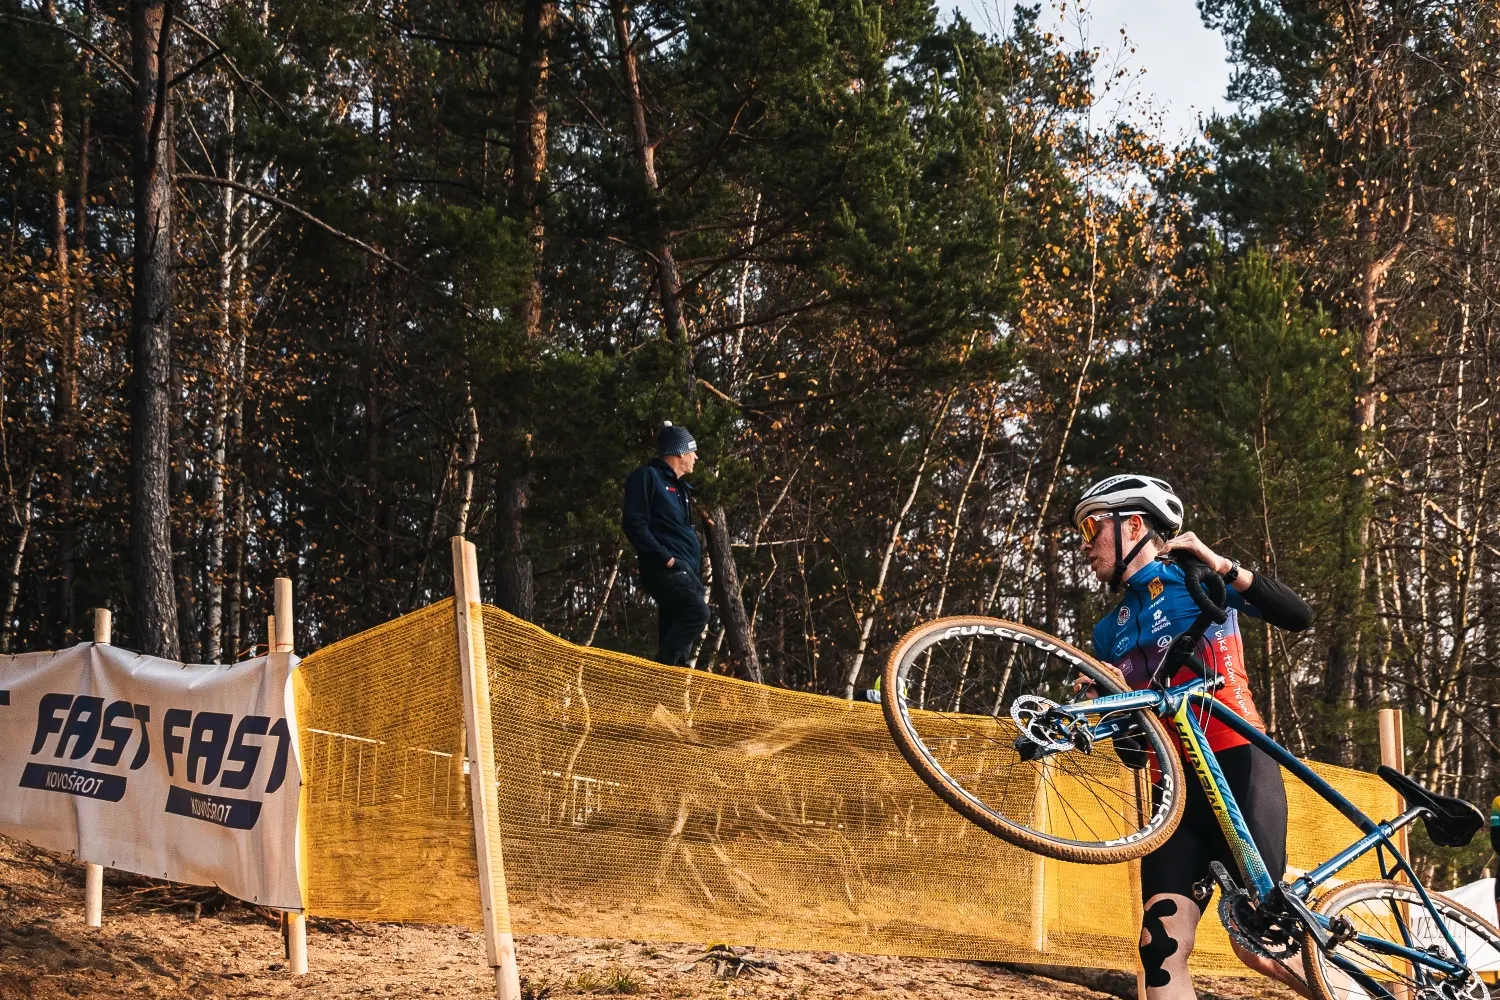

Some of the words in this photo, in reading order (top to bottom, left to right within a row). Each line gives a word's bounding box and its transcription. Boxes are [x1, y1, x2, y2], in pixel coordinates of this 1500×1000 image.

[944, 625, 1084, 666] FULCRUM
[1214, 629, 1228, 652] bike
[1223, 654, 1236, 684] team
[1093, 690, 1147, 705] MERIDA
[30, 693, 150, 770] FAST
[46, 770, 103, 795] KOVOŠROT
[190, 797, 232, 823] KOVOŠROT
